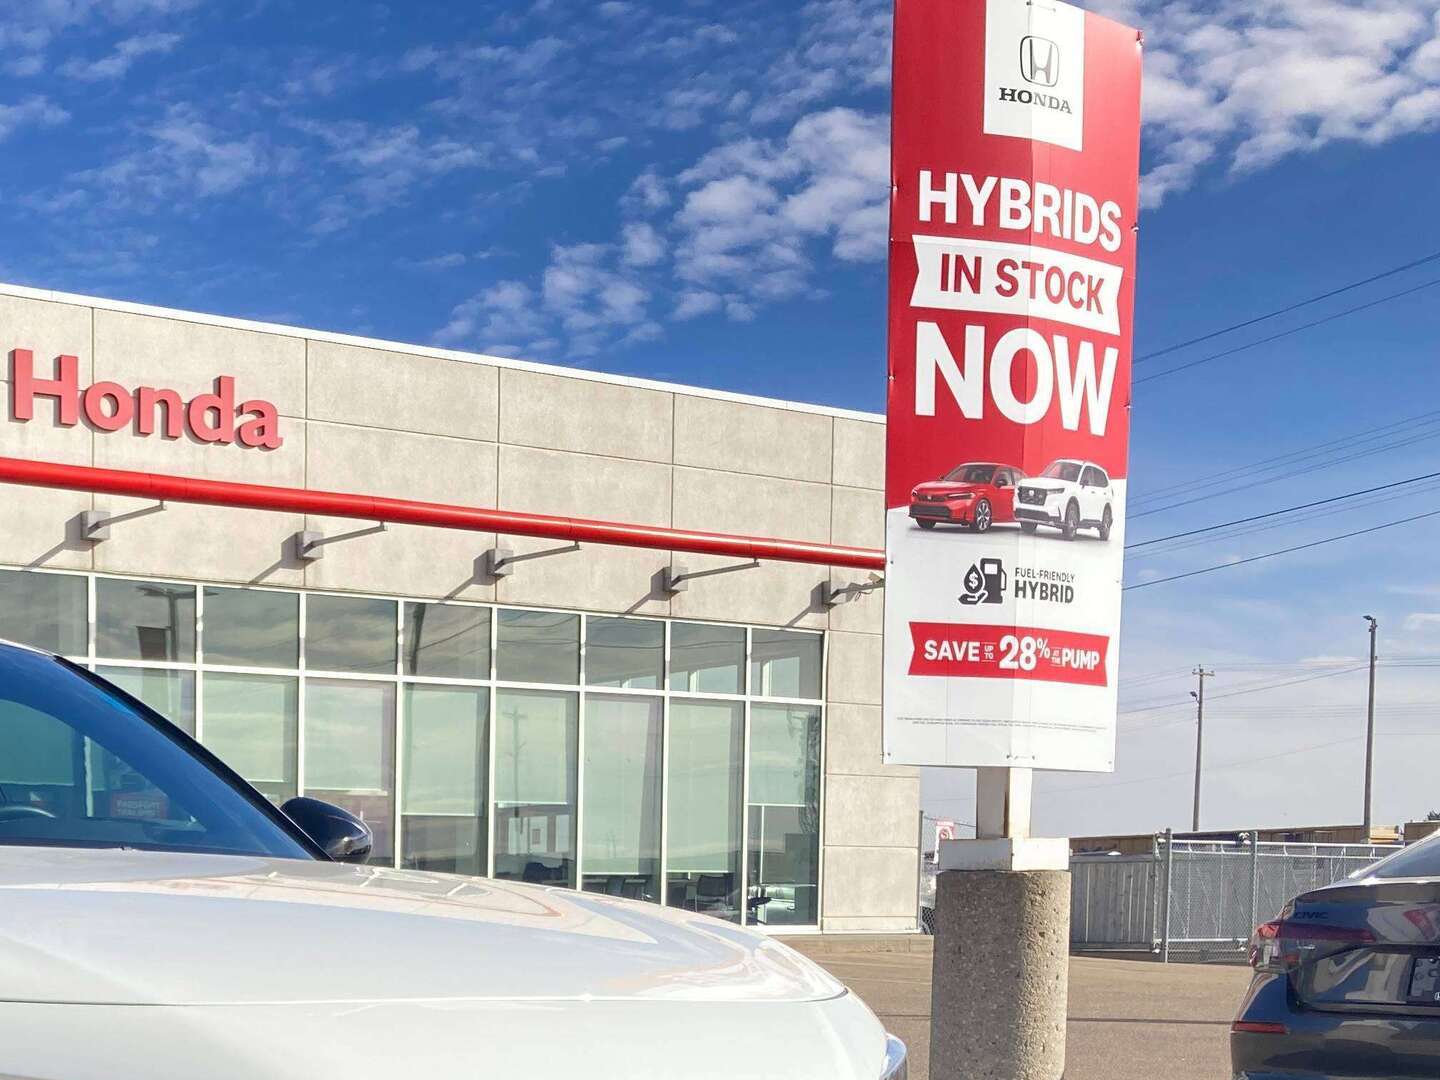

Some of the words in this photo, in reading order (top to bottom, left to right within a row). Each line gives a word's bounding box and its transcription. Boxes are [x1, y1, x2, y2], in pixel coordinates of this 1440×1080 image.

[998, 87, 1073, 115] HONDA
[918, 169, 1122, 252] HYBRIDS
[940, 253, 983, 294] IN
[994, 258, 1105, 315] STOCK
[914, 320, 1120, 437] NOW
[9, 349, 284, 449] Honda
[1015, 567, 1076, 583] FUEL-FRIENDLY
[1014, 580, 1075, 604] HYBRID
[924, 640, 980, 662] SAVE
[984, 652, 994, 660] TO
[1062, 648, 1101, 670] PUMP
[1294, 911, 1329, 920] CIVIC
